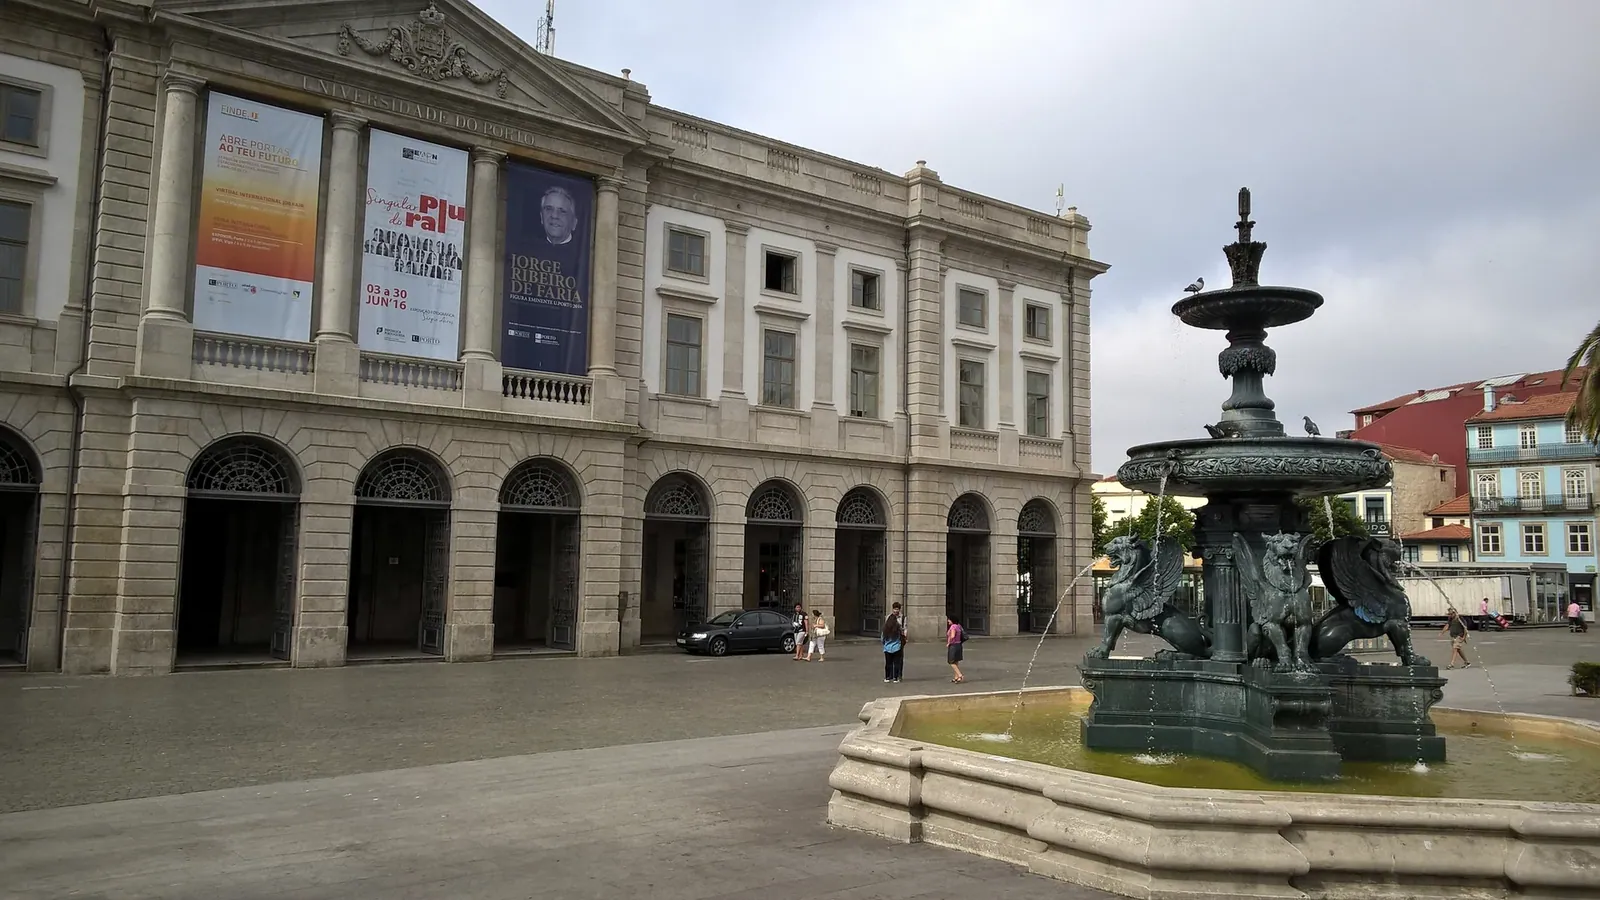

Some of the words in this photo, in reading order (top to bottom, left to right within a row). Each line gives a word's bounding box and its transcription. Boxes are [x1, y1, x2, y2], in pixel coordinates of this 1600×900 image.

[303, 76, 449, 125] UNIVERSIDADE
[456, 115, 478, 131] DO
[484, 122, 535, 146] PORTO
[218, 143, 234, 153] AO
[236, 146, 256, 158] TEU
[258, 151, 299, 167] FUTURO
[219, 134, 248, 147] ABRE
[250, 140, 291, 156] PORTAS
[215, 187, 239, 196] VIRTUAL
[239, 192, 282, 205] INTERNATIONAL
[366, 188, 418, 211] Singular
[388, 212, 402, 226] do
[510, 253, 562, 275] JORGE
[511, 267, 576, 289] RIBEIRO
[366, 284, 381, 294] 03
[383, 288, 390, 296] a
[393, 288, 407, 299] 30
[509, 293, 528, 301] FIGURA
[528, 297, 553, 305] EMINENTE
[510, 280, 533, 296] DE
[537, 284, 582, 303] FARIA
